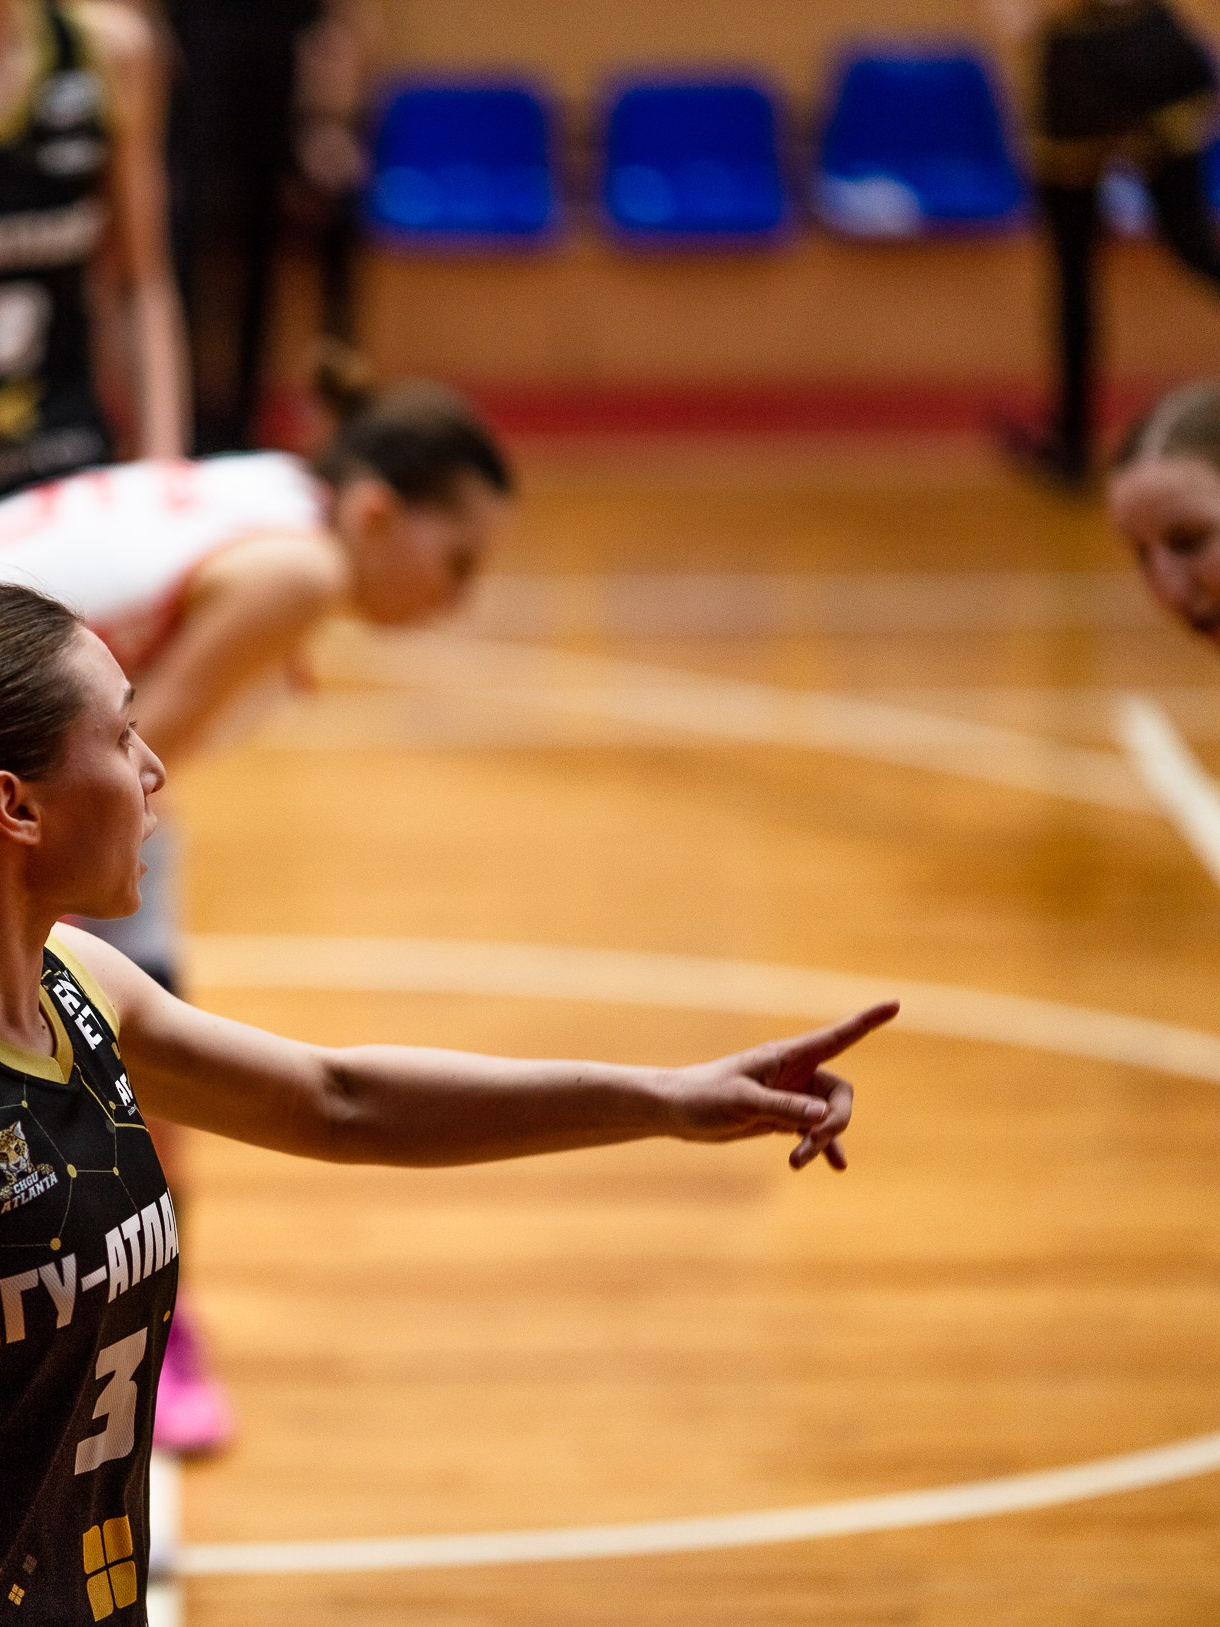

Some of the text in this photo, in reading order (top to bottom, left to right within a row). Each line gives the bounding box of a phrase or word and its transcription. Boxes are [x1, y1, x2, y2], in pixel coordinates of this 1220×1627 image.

[0, 1171, 59, 1214] ATLANTA
[13, 1171, 39, 1194] CHGU
[74, 1326, 149, 1476] 3
